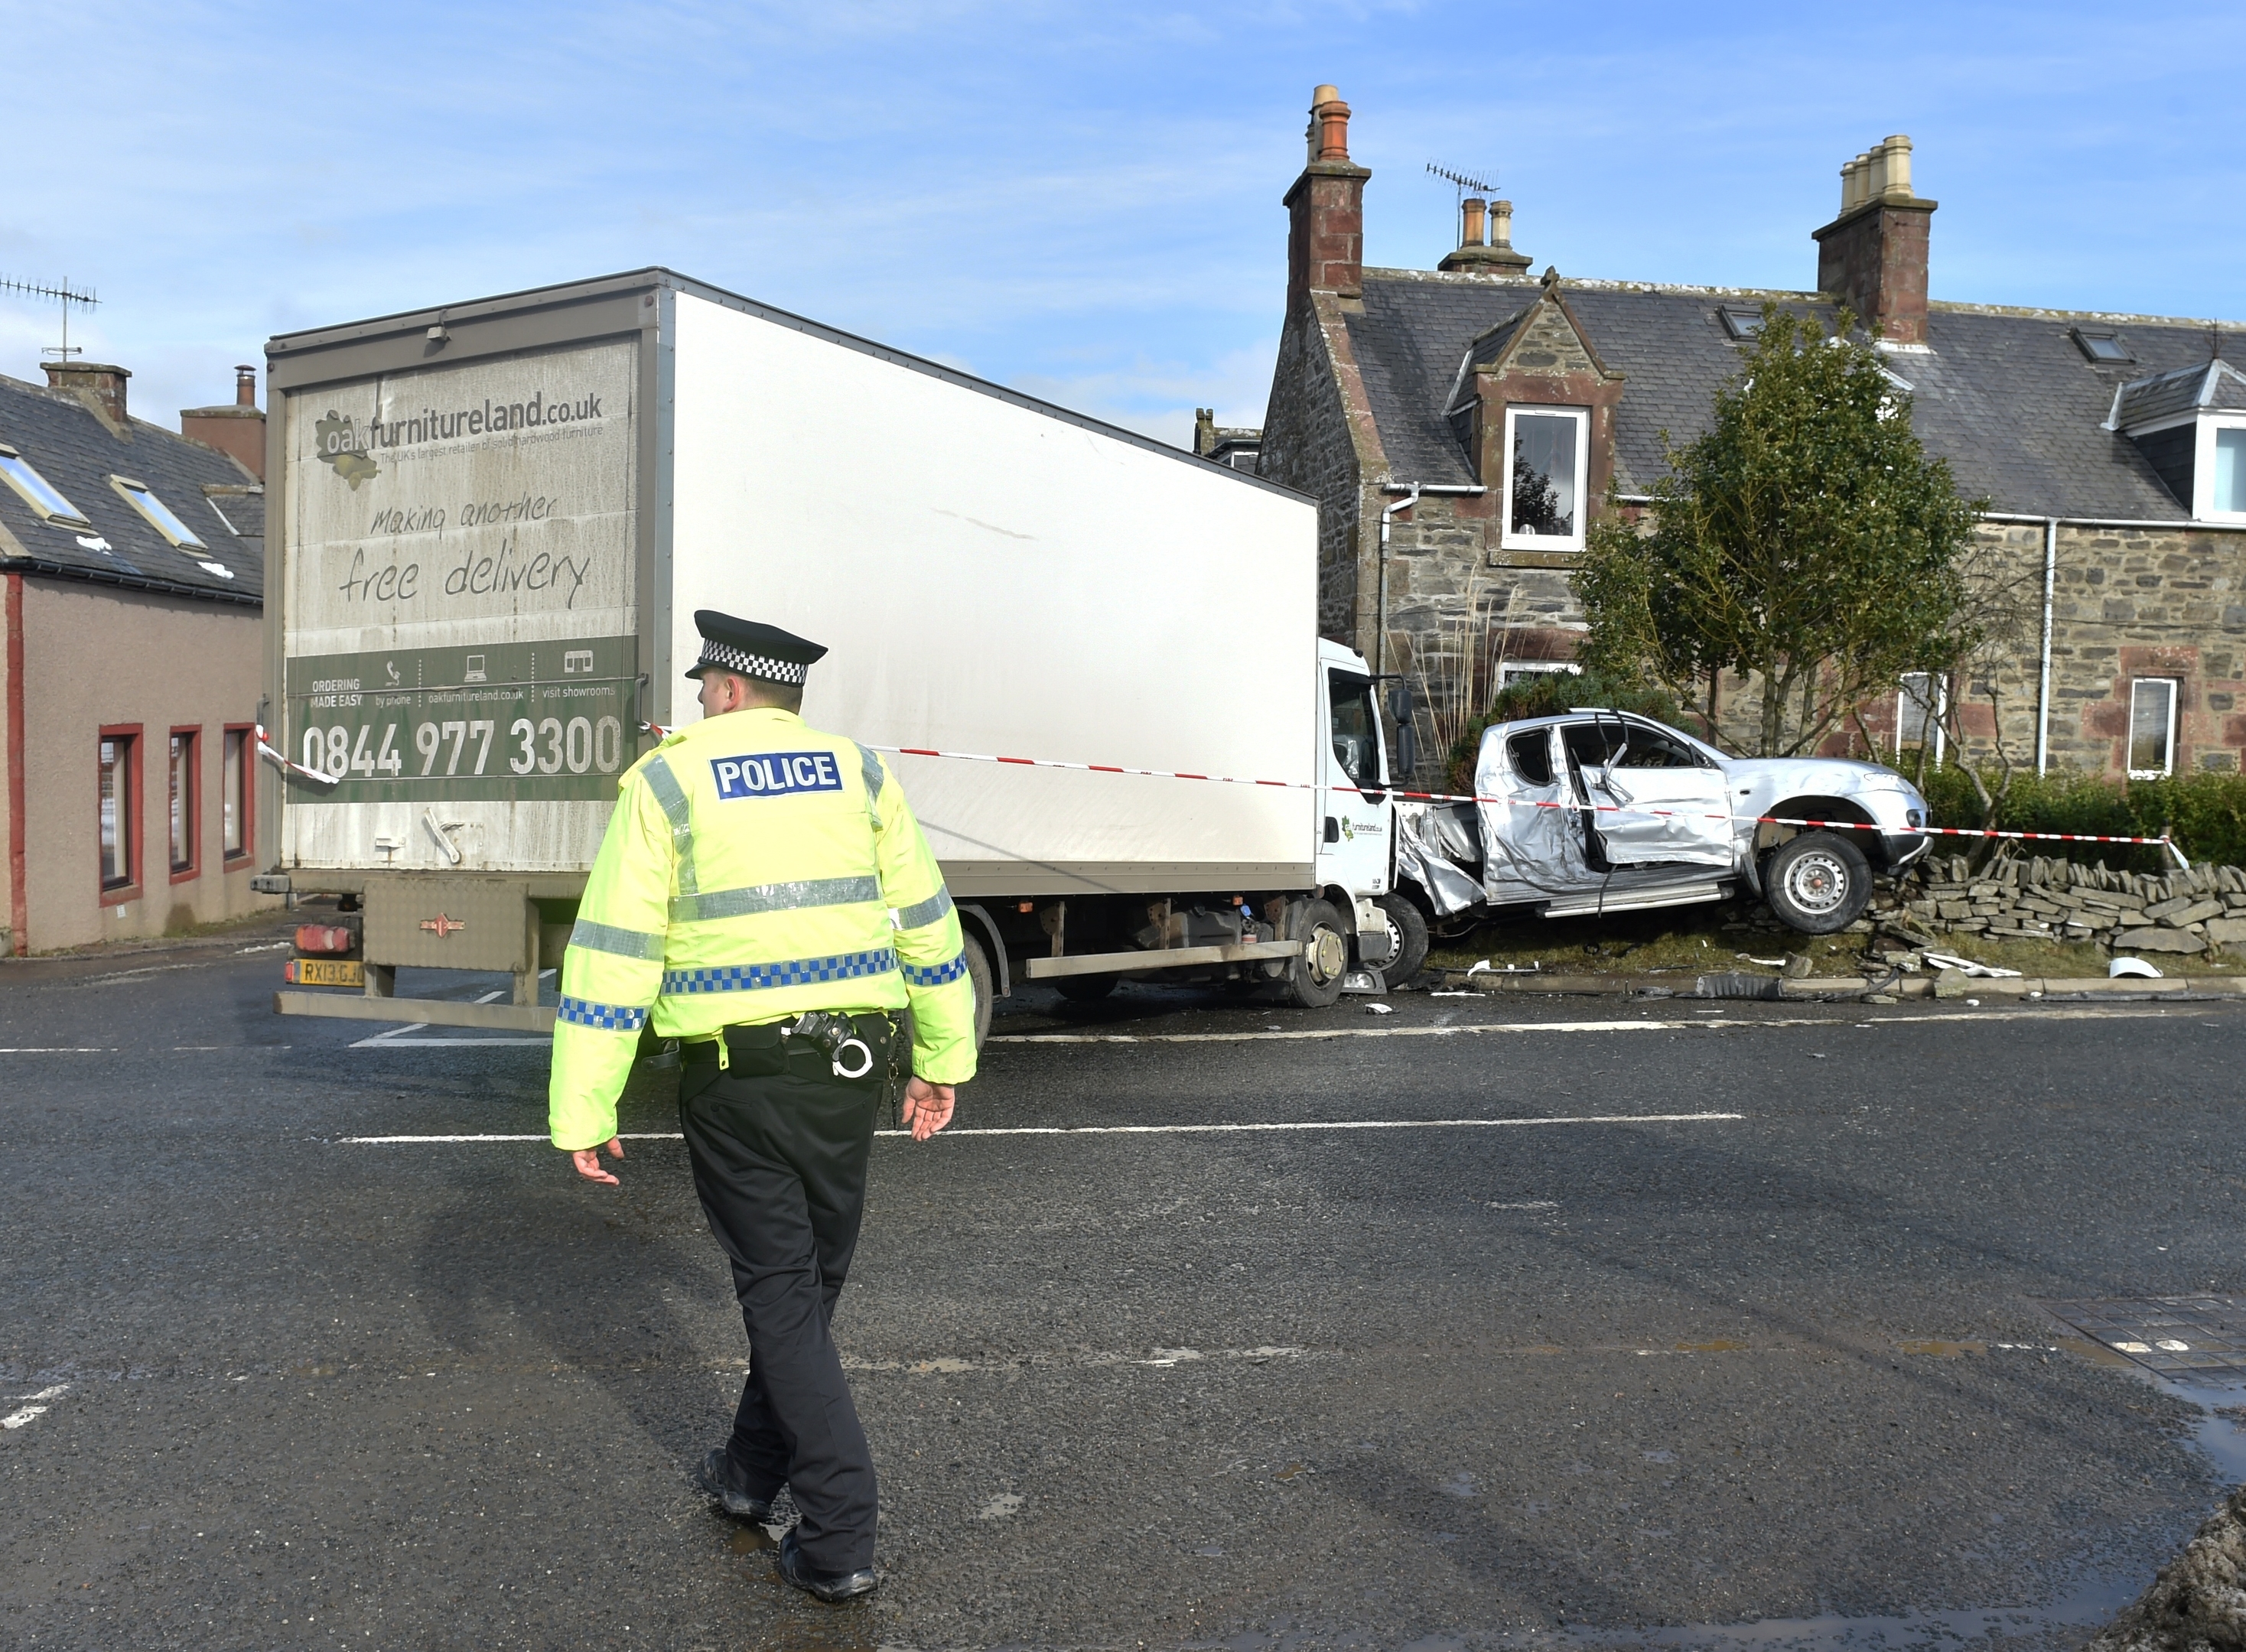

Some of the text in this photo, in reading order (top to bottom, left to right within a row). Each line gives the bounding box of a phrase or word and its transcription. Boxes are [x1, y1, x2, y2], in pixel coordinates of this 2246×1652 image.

[461, 491, 558, 527] another
[339, 538, 591, 610] free delivery
[312, 678, 360, 693] ORDERING
[542, 687, 615, 698] visit showrooms
[311, 694, 363, 708] MADE EASY
[376, 695, 412, 708] by phone
[428, 689, 524, 704] oakfurnitureland.co.uk
[303, 715, 621, 779] 0844 977 3300
[717, 756, 837, 793] POLICE
[304, 963, 336, 982] RX13
